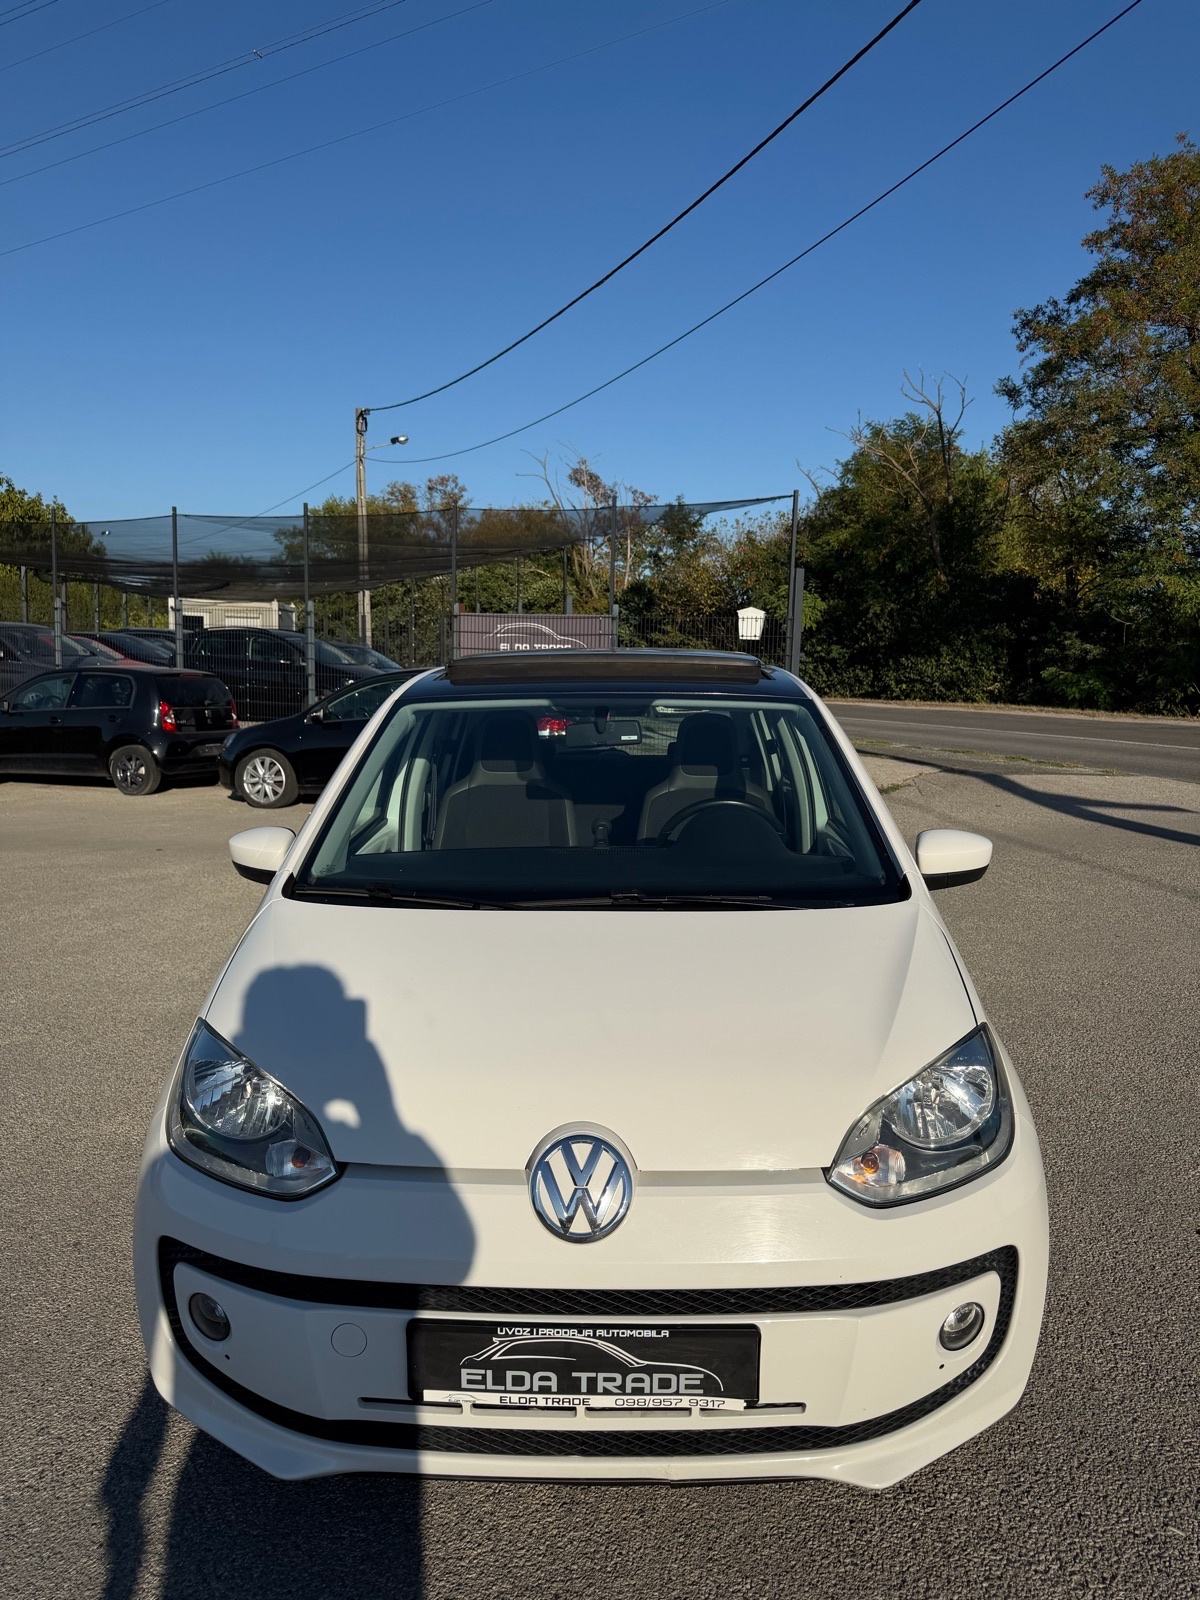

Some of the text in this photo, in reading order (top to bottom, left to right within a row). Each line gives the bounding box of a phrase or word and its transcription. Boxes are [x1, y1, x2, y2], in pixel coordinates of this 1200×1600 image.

[497, 1327, 531, 1336] UVOZ
[538, 1328, 594, 1337] PRODAJA
[596, 1329, 670, 1338] AUTOMOBILA
[460, 1368, 705, 1394] ELDA TRADE
[499, 1395, 726, 1408] ELDA TRADE 098/957 9317
